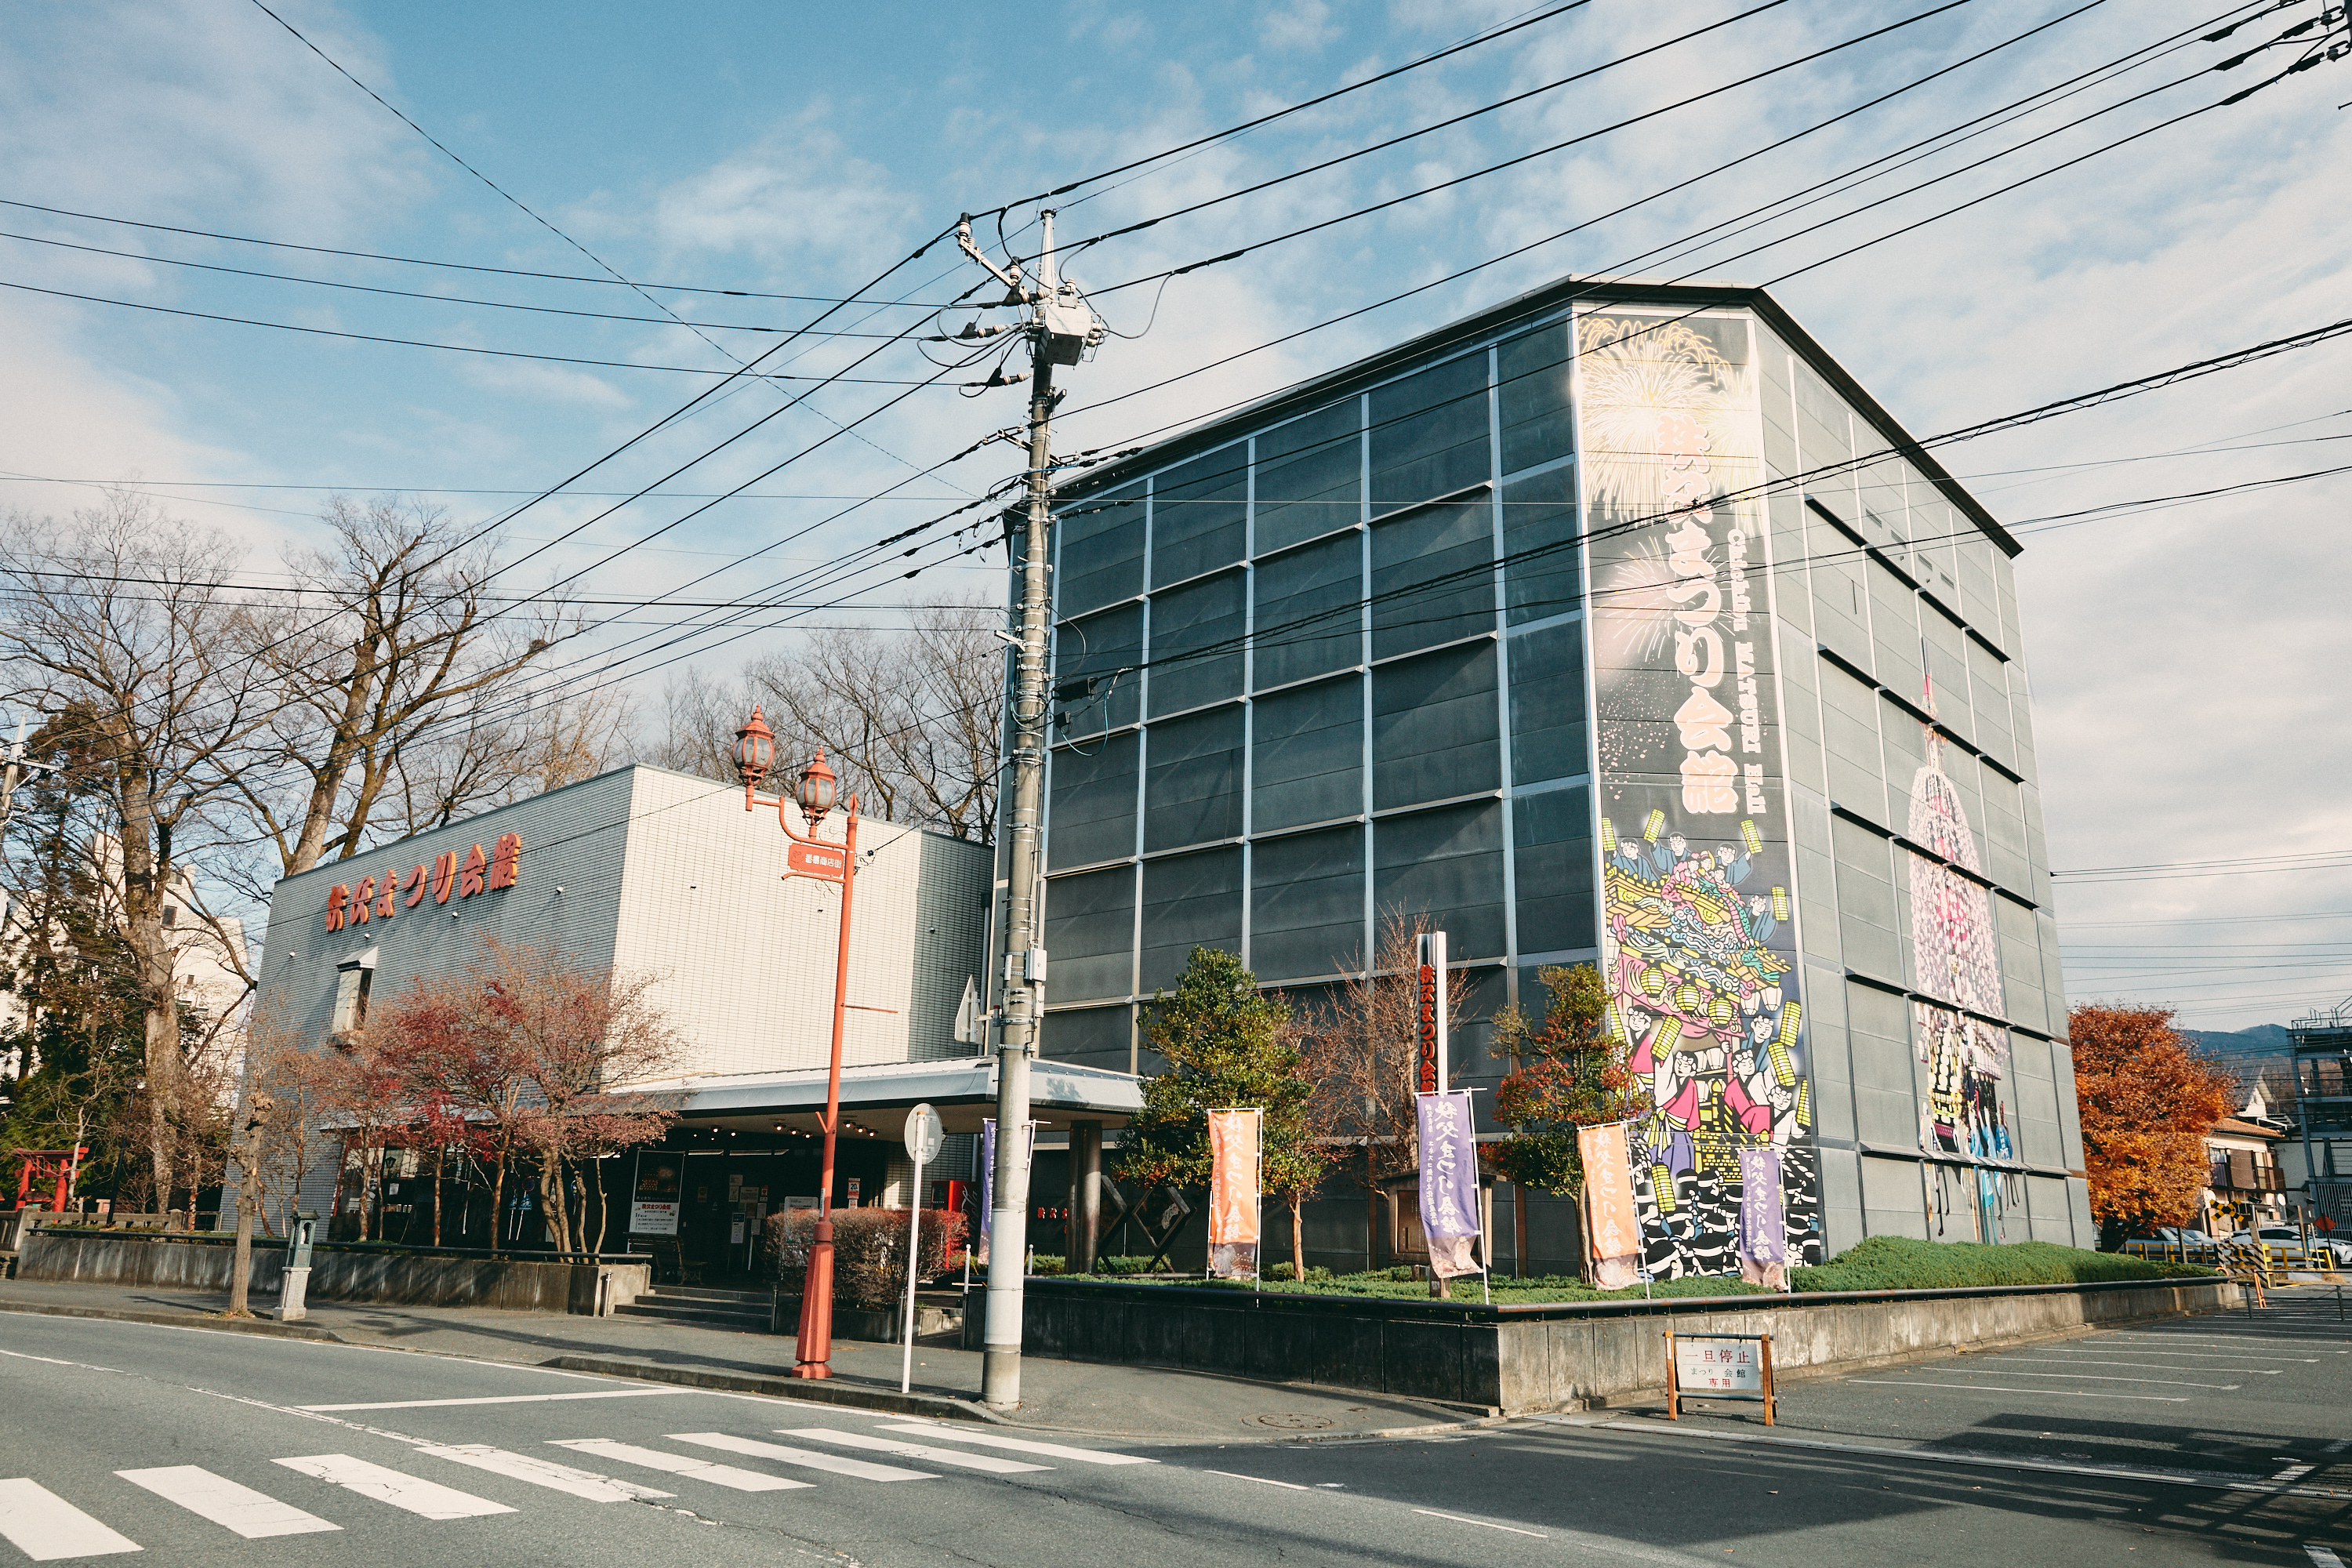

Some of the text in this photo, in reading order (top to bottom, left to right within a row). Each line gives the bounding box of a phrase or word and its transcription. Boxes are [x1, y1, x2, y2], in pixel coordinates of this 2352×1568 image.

[1657, 415, 1739, 815] 秩父まつり会館
[1726, 528, 1767, 815] Chichibu MATSURI Hall
[325, 832, 522, 932] 秩父まつり会館
[1685, 1349, 1750, 1363] 一旦停止
[1708, 1377, 1731, 1388] 専用
[1724, 1368, 1746, 1377] 会館
